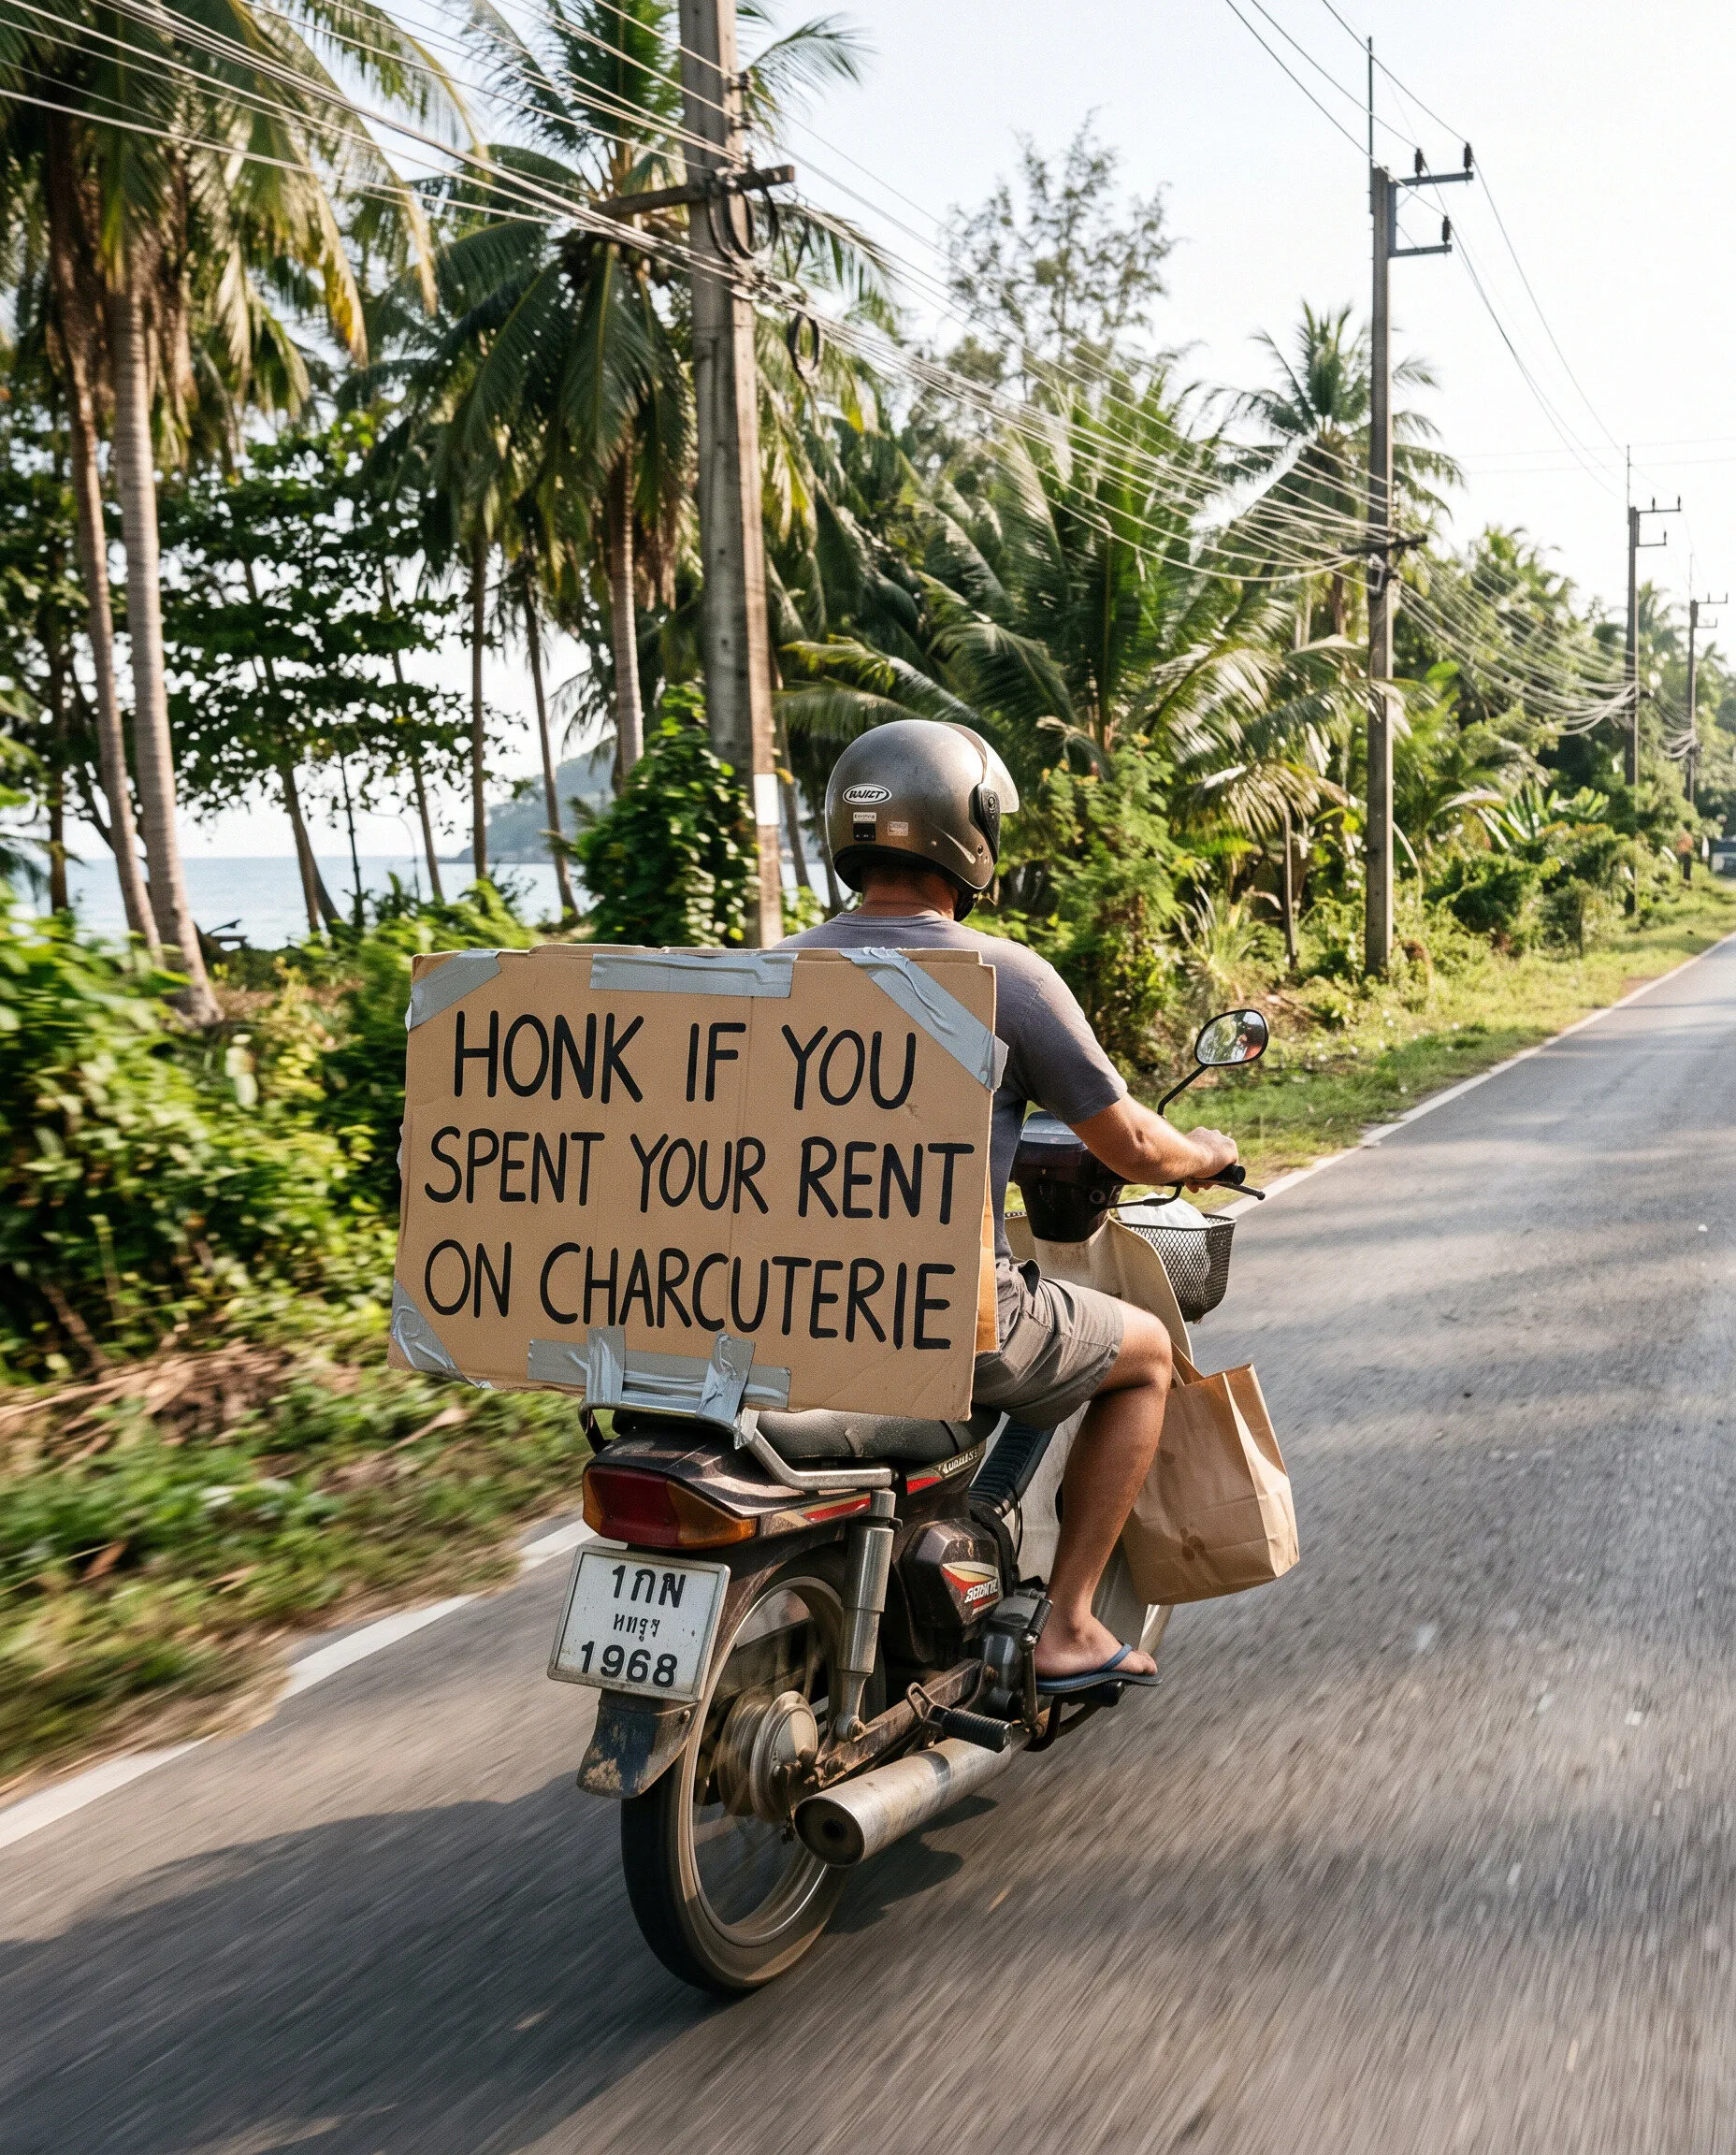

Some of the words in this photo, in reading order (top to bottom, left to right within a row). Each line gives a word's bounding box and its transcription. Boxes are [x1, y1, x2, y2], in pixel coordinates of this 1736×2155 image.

[454, 1009, 644, 1105] HONK
[686, 1021, 747, 1103] IF
[780, 1024, 917, 1111] YOU
[424, 1125, 606, 1207] SPENT
[629, 1133, 770, 1215] YOUR
[798, 1135, 976, 1225] RENT
[424, 1238, 514, 1319] ON
[539, 1241, 957, 1351] CHARCUTERIE
[581, 1641, 678, 1689] 1968
